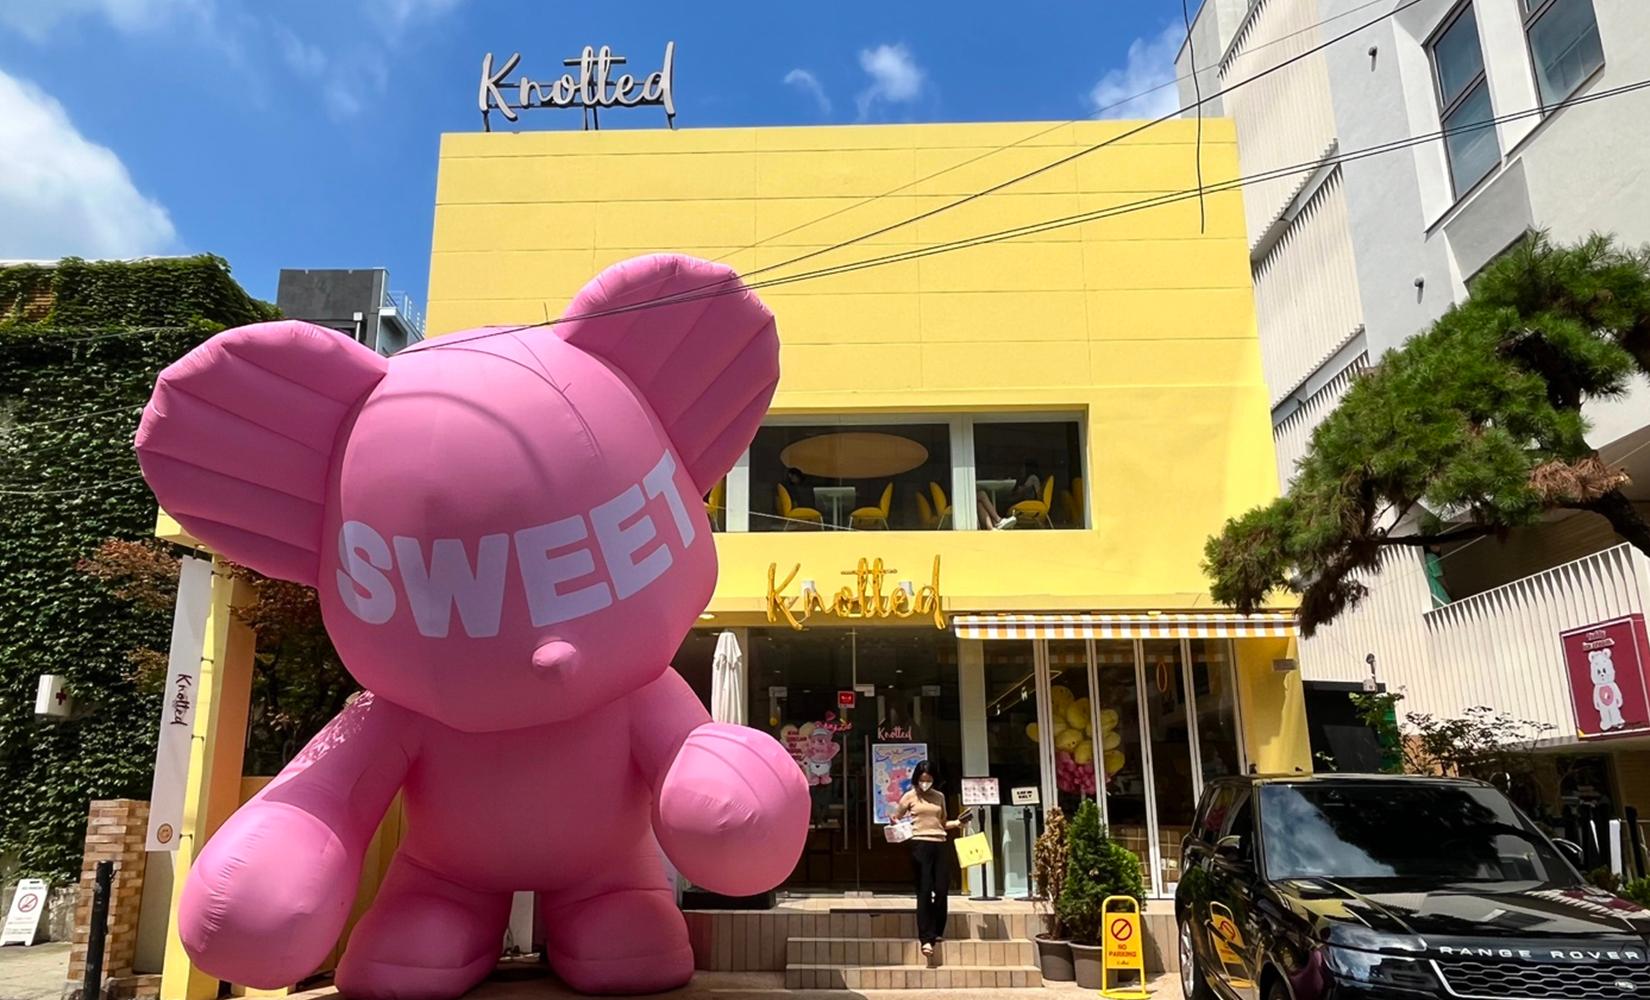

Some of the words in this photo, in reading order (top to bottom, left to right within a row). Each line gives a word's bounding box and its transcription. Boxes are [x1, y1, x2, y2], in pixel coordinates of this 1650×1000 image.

[478, 40, 676, 120] Knotted
[336, 448, 695, 638] SWEET
[766, 554, 946, 630] Knotted
[170, 674, 192, 726] Knotted
[877, 726, 912, 740] Knotted
[1439, 946, 1531, 958] RANGE
[1550, 950, 1640, 960] ROVER
